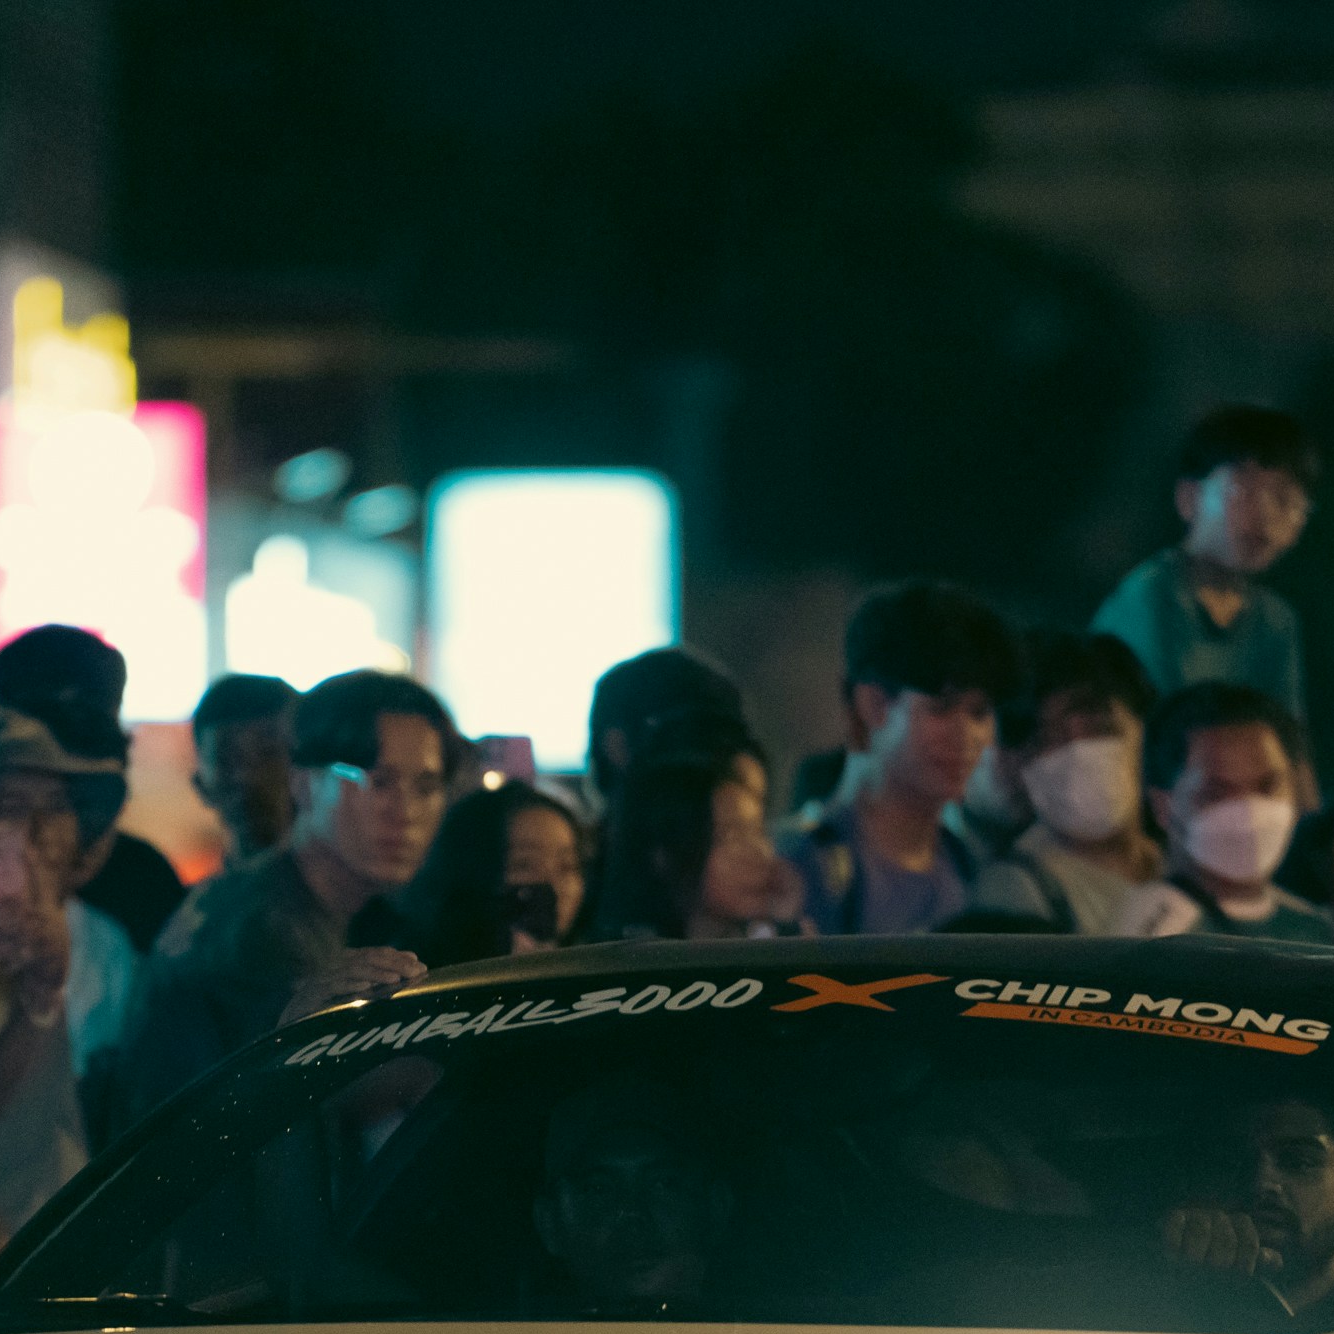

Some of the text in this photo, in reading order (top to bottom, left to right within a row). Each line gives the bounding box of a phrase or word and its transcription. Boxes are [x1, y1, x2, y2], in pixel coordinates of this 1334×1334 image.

[954, 978, 1112, 1008] CHIP
[1123, 996, 1332, 1042] MONG
[1027, 1008, 1248, 1043] IN CAMBODIA
